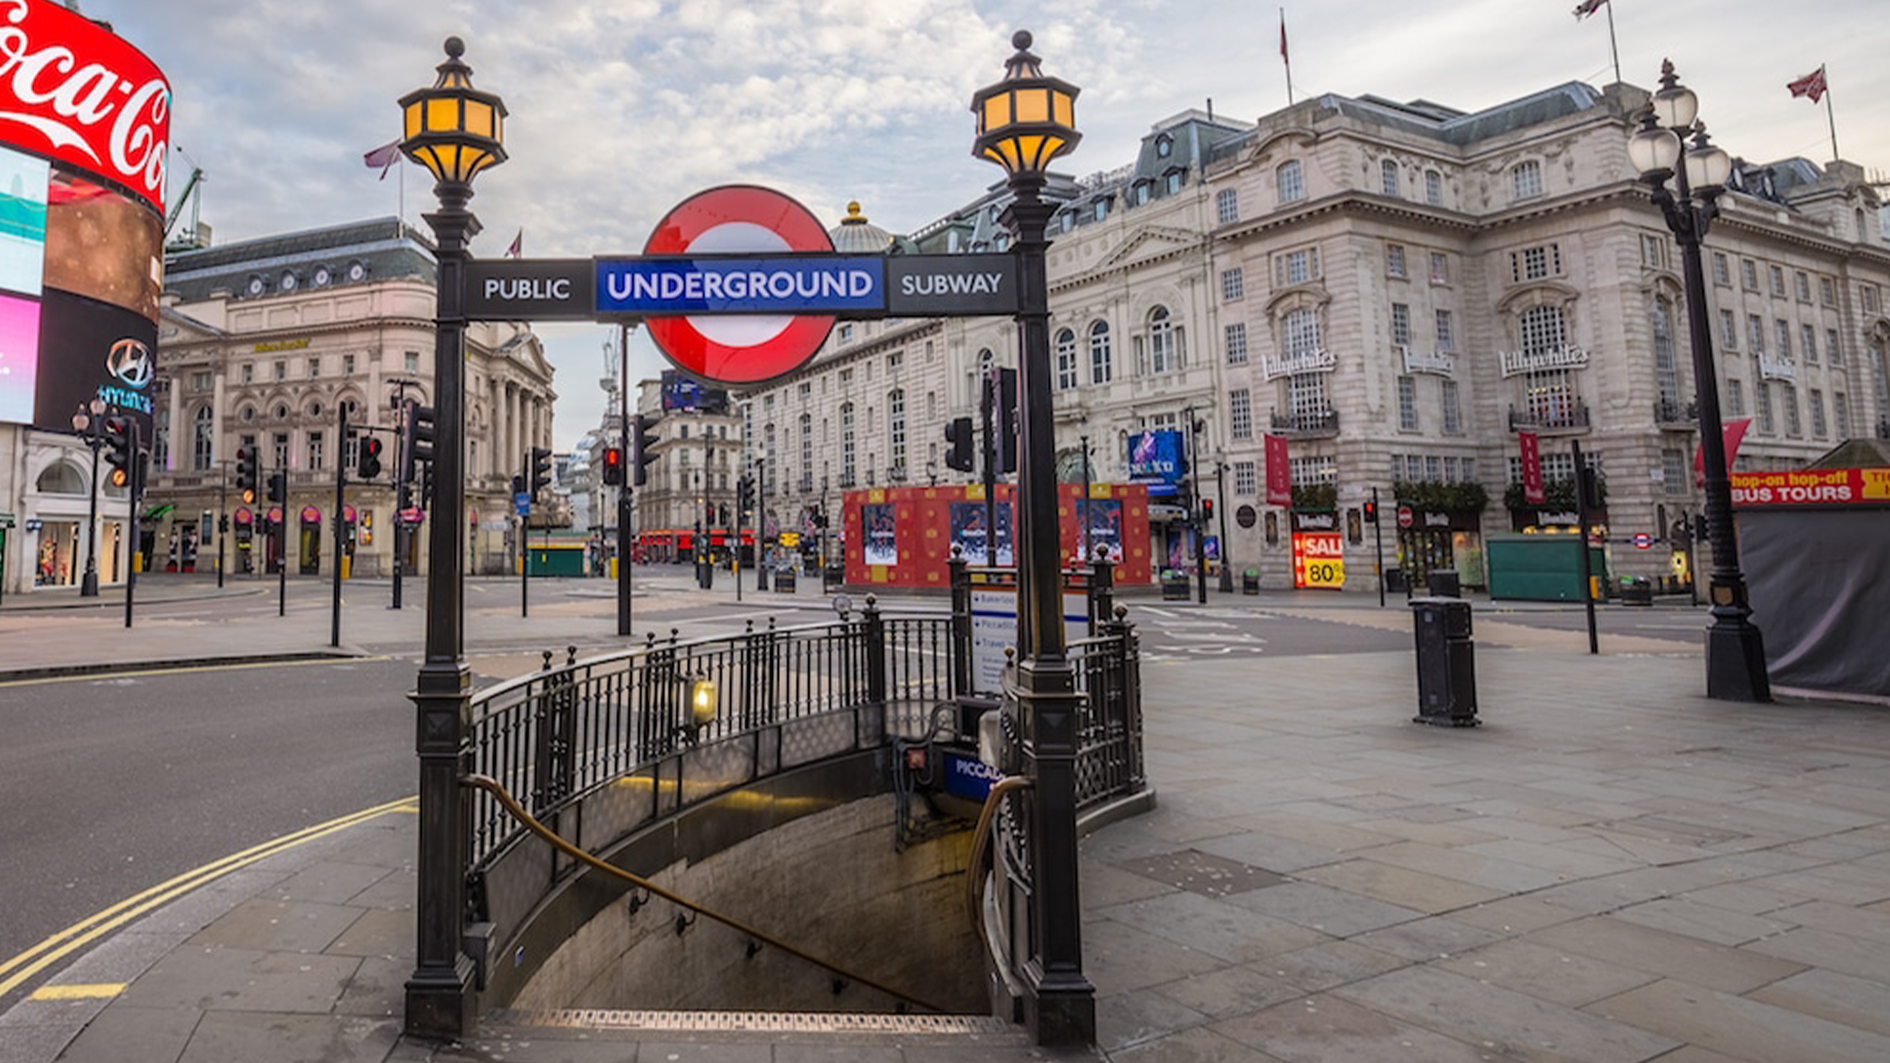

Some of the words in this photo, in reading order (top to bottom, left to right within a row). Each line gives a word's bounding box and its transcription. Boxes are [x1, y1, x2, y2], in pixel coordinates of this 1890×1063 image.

[484, 278, 571, 300] PUBLIC
[607, 271, 873, 300] UNDERGROUND
[901, 273, 1002, 297] SUBWAY
[1788, 470, 1848, 486] hop-off
[1731, 487, 1773, 503] BUS
[1777, 485, 1852, 501] TOURS
